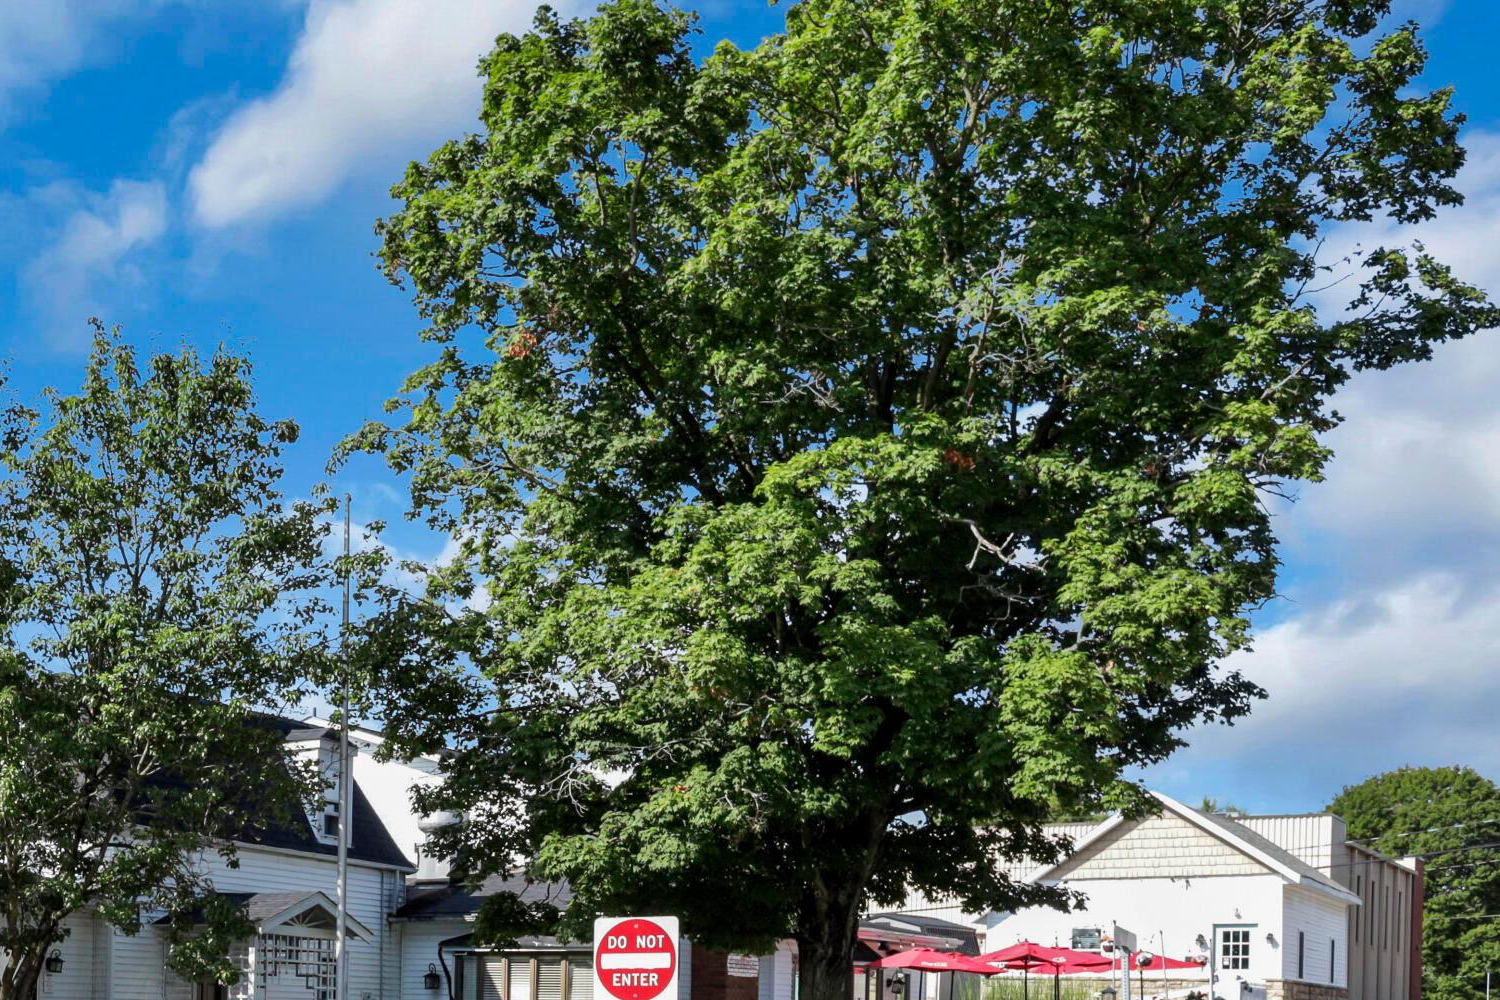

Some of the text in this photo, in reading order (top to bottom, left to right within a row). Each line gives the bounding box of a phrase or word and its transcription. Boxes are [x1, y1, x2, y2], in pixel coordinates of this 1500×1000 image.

[607, 935, 665, 949] DO NOT
[612, 973, 659, 987] ENTER
